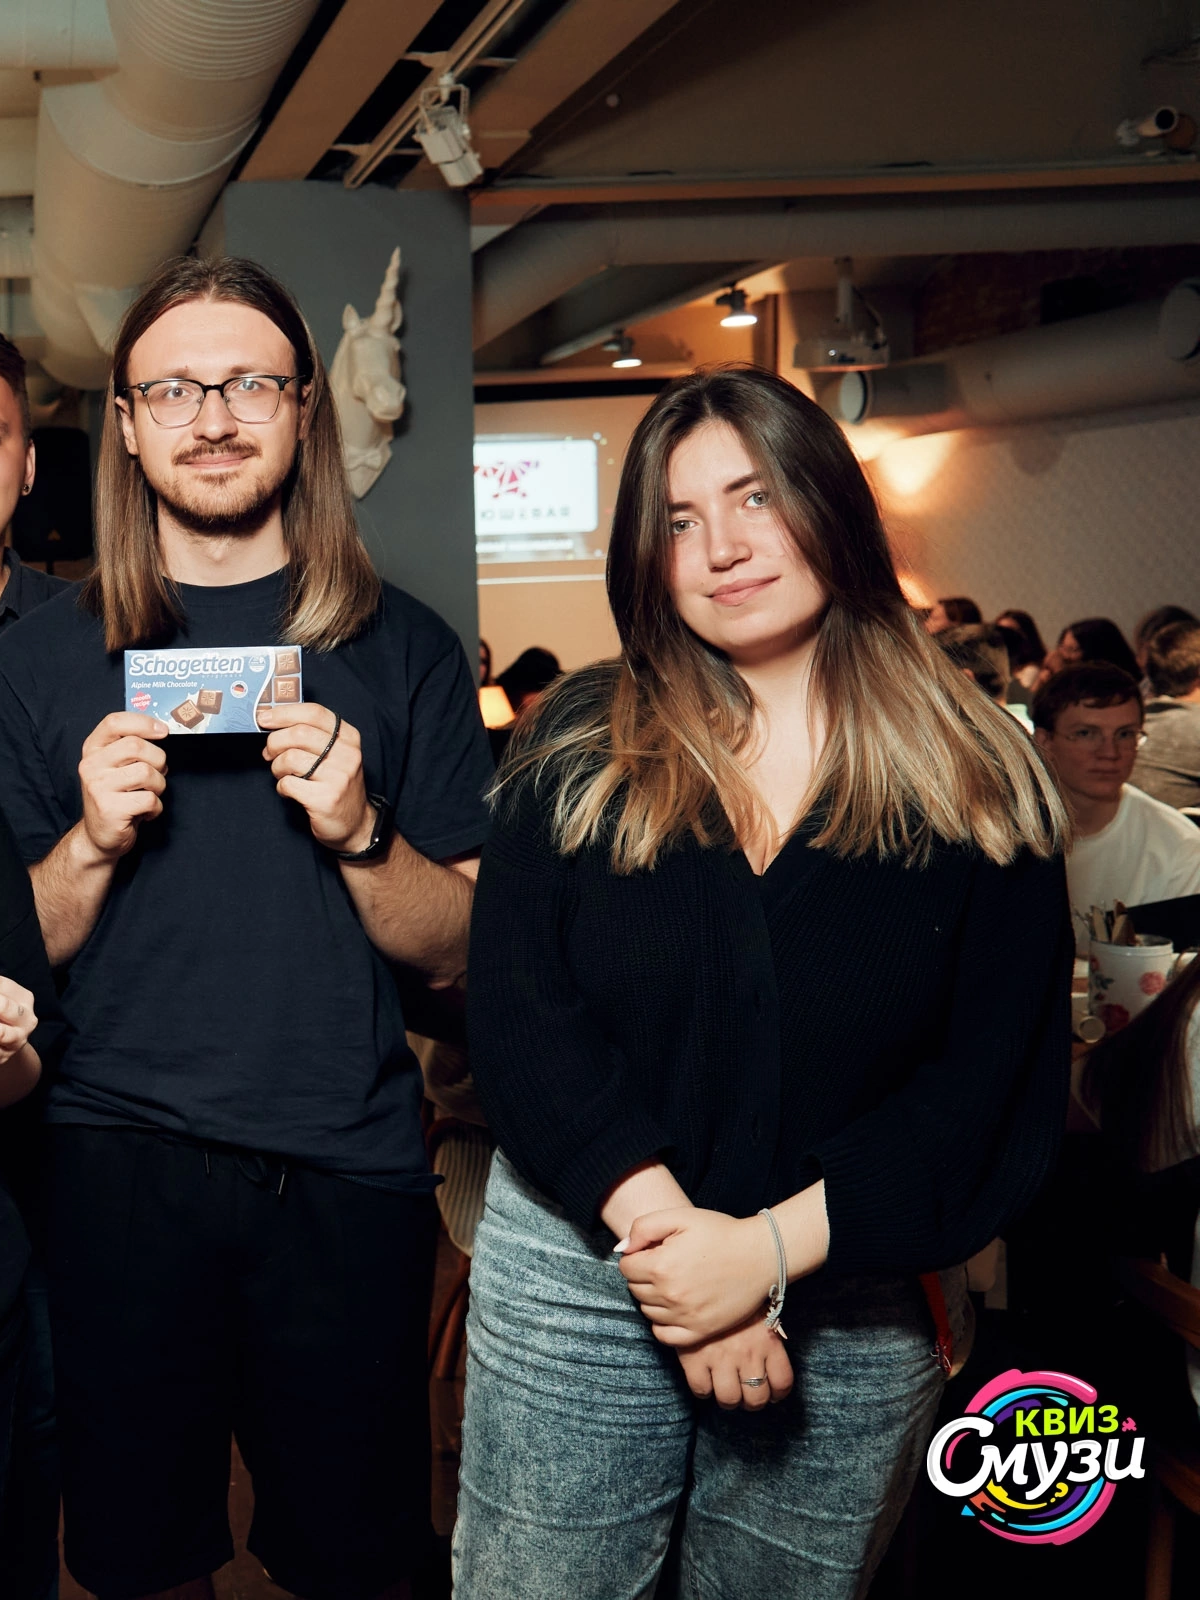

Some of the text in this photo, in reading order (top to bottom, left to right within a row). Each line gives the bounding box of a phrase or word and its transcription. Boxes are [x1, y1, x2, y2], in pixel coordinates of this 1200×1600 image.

[130, 654, 243, 678] Schogetten
[131, 682, 151, 690] Alpine
[131, 693, 151, 703] smooth
